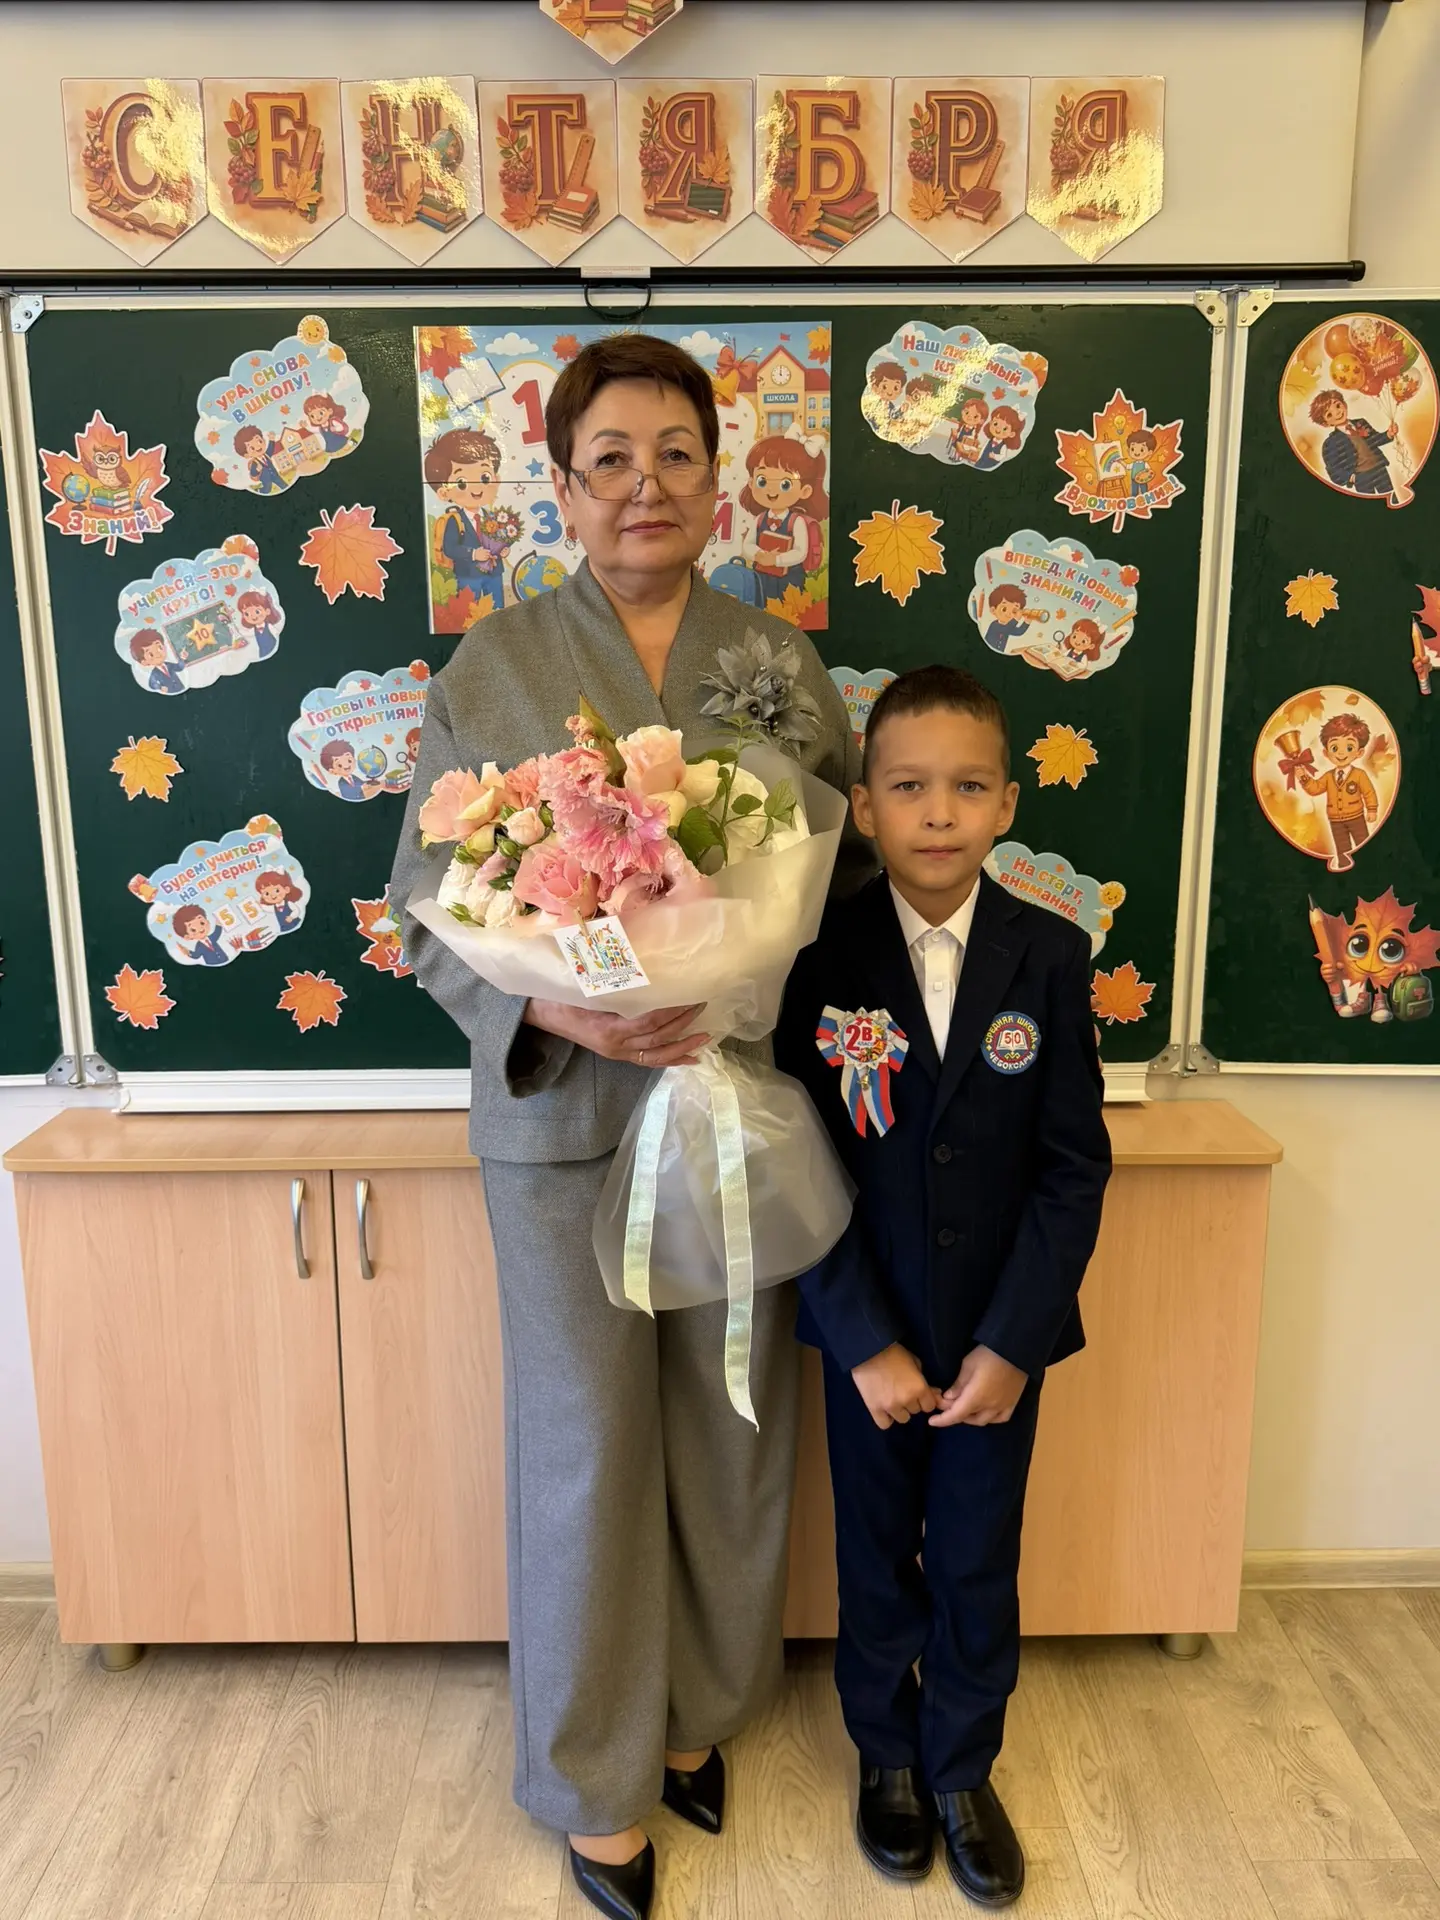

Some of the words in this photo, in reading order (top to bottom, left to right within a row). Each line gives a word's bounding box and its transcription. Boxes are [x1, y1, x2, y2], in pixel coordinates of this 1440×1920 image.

[903, 335, 940, 354] Наш
[216, 384, 254, 410] УРА,
[252, 353, 311, 386] СНОВА
[231, 409, 246, 423] В
[244, 371, 311, 414] ШКОЛУ!
[766, 394, 795, 402] ШКОЛА
[1065, 475, 1179, 511] Вдохновения!
[68, 508, 158, 534] Знаний!
[128, 575, 195, 617] УЧИТЬСЯ
[210, 564, 239, 579] ЭТО
[1004, 551, 1062, 577] ВПЕРЕД,
[1065, 568, 1077, 580] К
[1078, 573, 1128, 608] НОВЫМ
[1021, 572, 1102, 613] ЗНАНИЯМ!
[162, 585, 216, 616] КРУТО!
[194, 628, 209, 641] 10
[843, 683, 855, 697] Я
[307, 699, 363, 725] Готовы
[380, 690, 428, 704] новы
[326, 703, 424, 737] открытиям!
[160, 863, 206, 894] Будем
[206, 840, 267, 871] учиться
[179, 885, 198, 902] на
[197, 855, 262, 891] пятерки!
[1012, 857, 1036, 877] На
[1038, 871, 1084, 905] старт,
[219, 909, 235, 926] 5
[243, 901, 258, 919] 5
[999, 872, 1079, 922] внимание,
[985, 1015, 1014, 1043] СРЕДНЯЯ
[1016, 1016, 1038, 1043] ШКОЛА
[1004, 1032, 1021, 1045] 50
[989, 1051, 1035, 1070] ЧЕБОКСАРЫ
